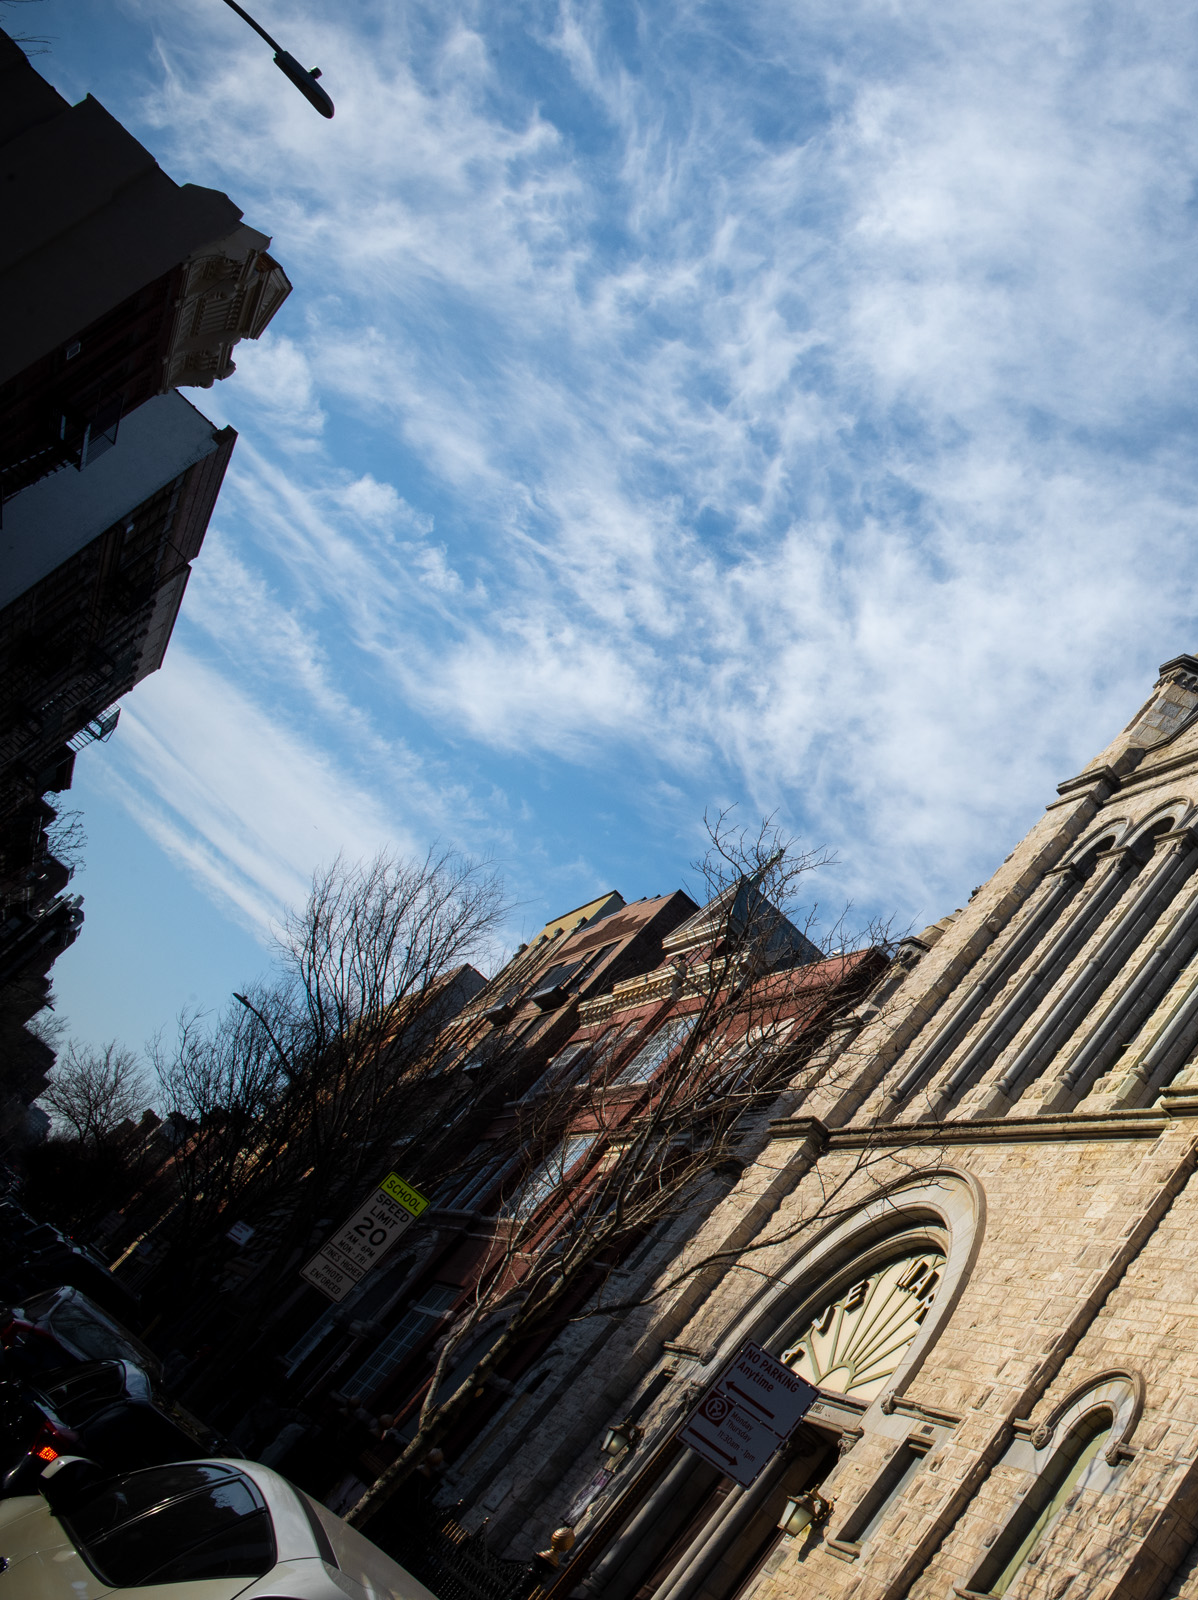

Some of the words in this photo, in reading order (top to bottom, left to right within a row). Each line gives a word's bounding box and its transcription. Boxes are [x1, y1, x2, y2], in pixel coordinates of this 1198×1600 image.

[376, 1194, 409, 1223] SPEED
[387, 1181, 419, 1212] SCHOOL
[354, 1217, 387, 1246] 20
[370, 1206, 398, 1229] LIMIT
[338, 1240, 352, 1254] MON
[354, 1254, 367, 1265] FRI
[344, 1231, 358, 1245] 7AM
[360, 1245, 376, 1258] 6PM
[322, 1264, 344, 1283] PHOTO
[324, 1247, 342, 1262] FINES
[342, 1260, 362, 1278] HIGHER
[310, 1268, 341, 1295] ENFORCED
[737, 1361, 774, 1393] Anytime
[745, 1349, 761, 1364] NO
[760, 1359, 800, 1393] PARKING
[725, 1419, 752, 1442] Thursday
[731, 1411, 754, 1431] Monday
[717, 1431, 740, 1451] 11:30am
[743, 1449, 755, 1462] 1pm
